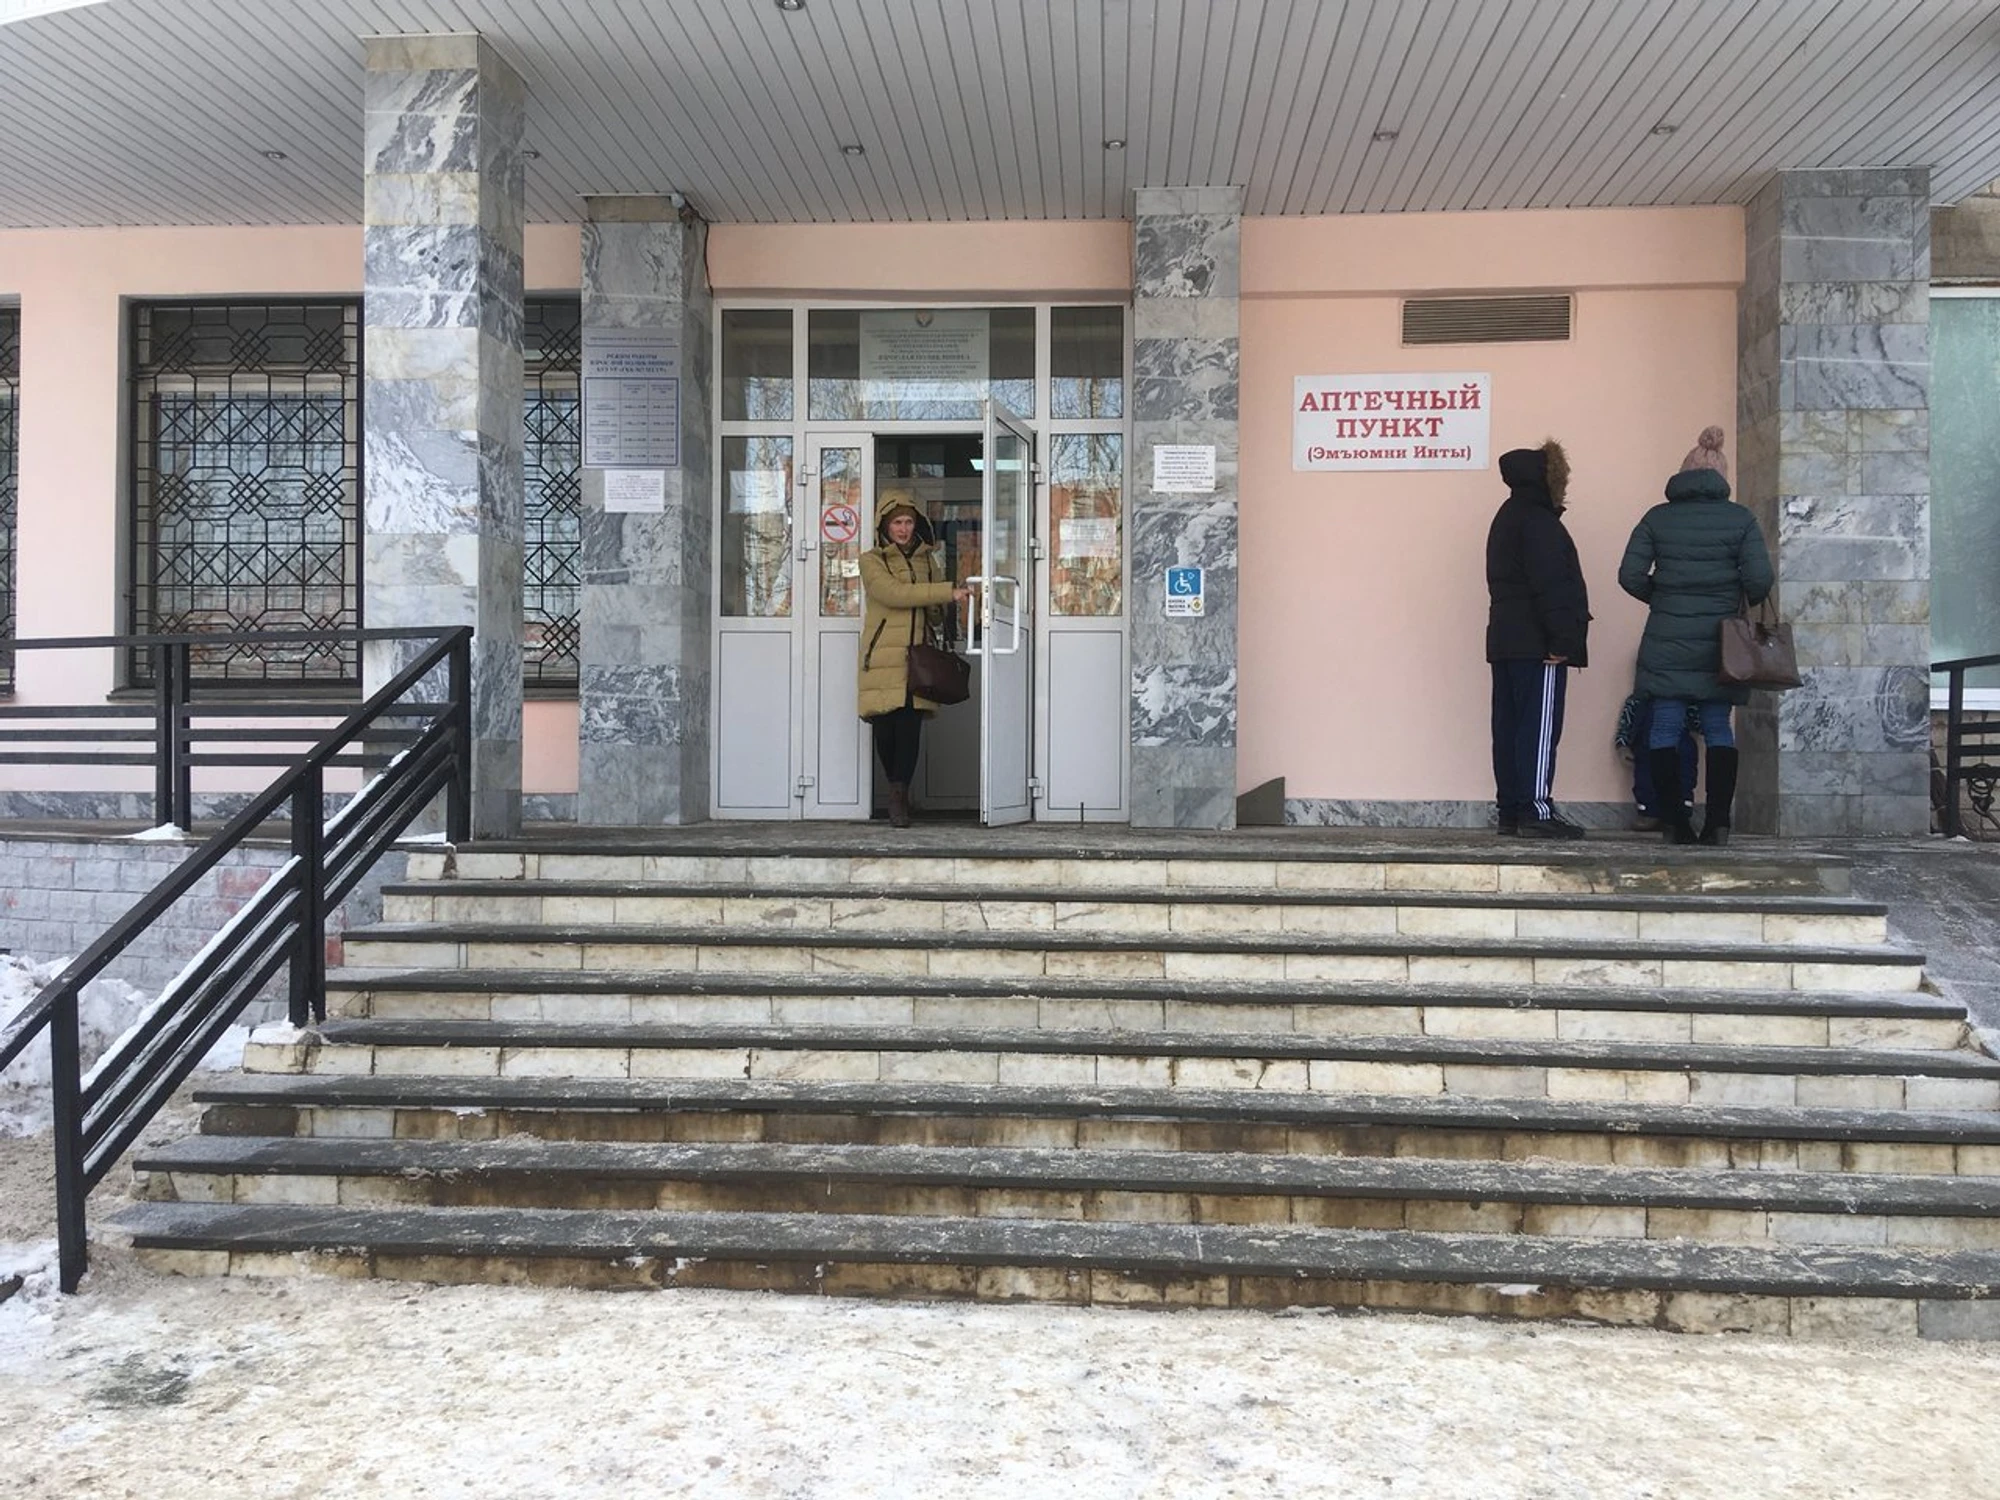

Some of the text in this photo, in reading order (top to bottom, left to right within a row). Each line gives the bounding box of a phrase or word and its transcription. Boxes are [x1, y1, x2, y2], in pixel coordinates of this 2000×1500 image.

[1299, 383, 1481, 412] АПТЕЧНЫЙ
[1336, 417, 1444, 439] ПУНКТ
[1307, 445, 1472, 462] (Эмъюмни Инты)
